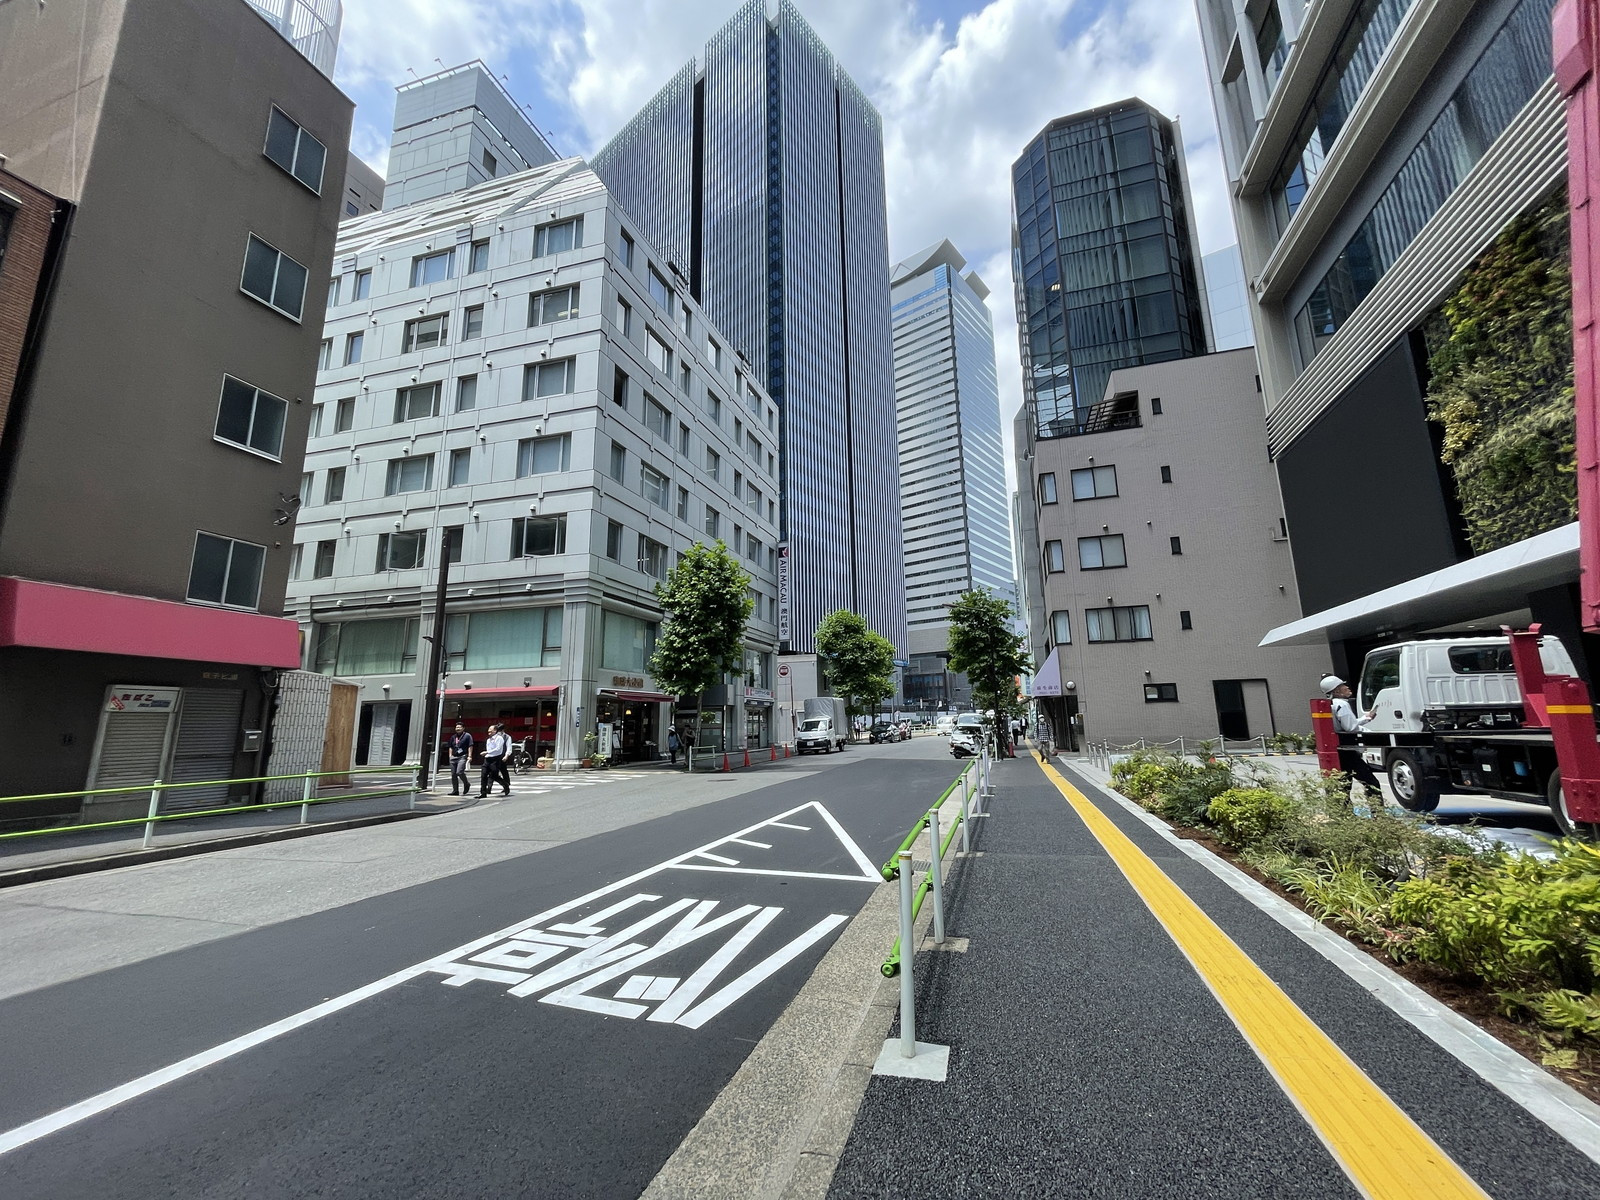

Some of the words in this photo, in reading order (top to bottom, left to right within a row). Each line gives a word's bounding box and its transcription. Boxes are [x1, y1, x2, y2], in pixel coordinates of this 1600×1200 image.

[779, 560, 788, 573] AIR
[779, 575, 788, 604] MACAU
[780, 608, 789, 635] 澳門航空
[429, 893, 849, 1029] バス停
